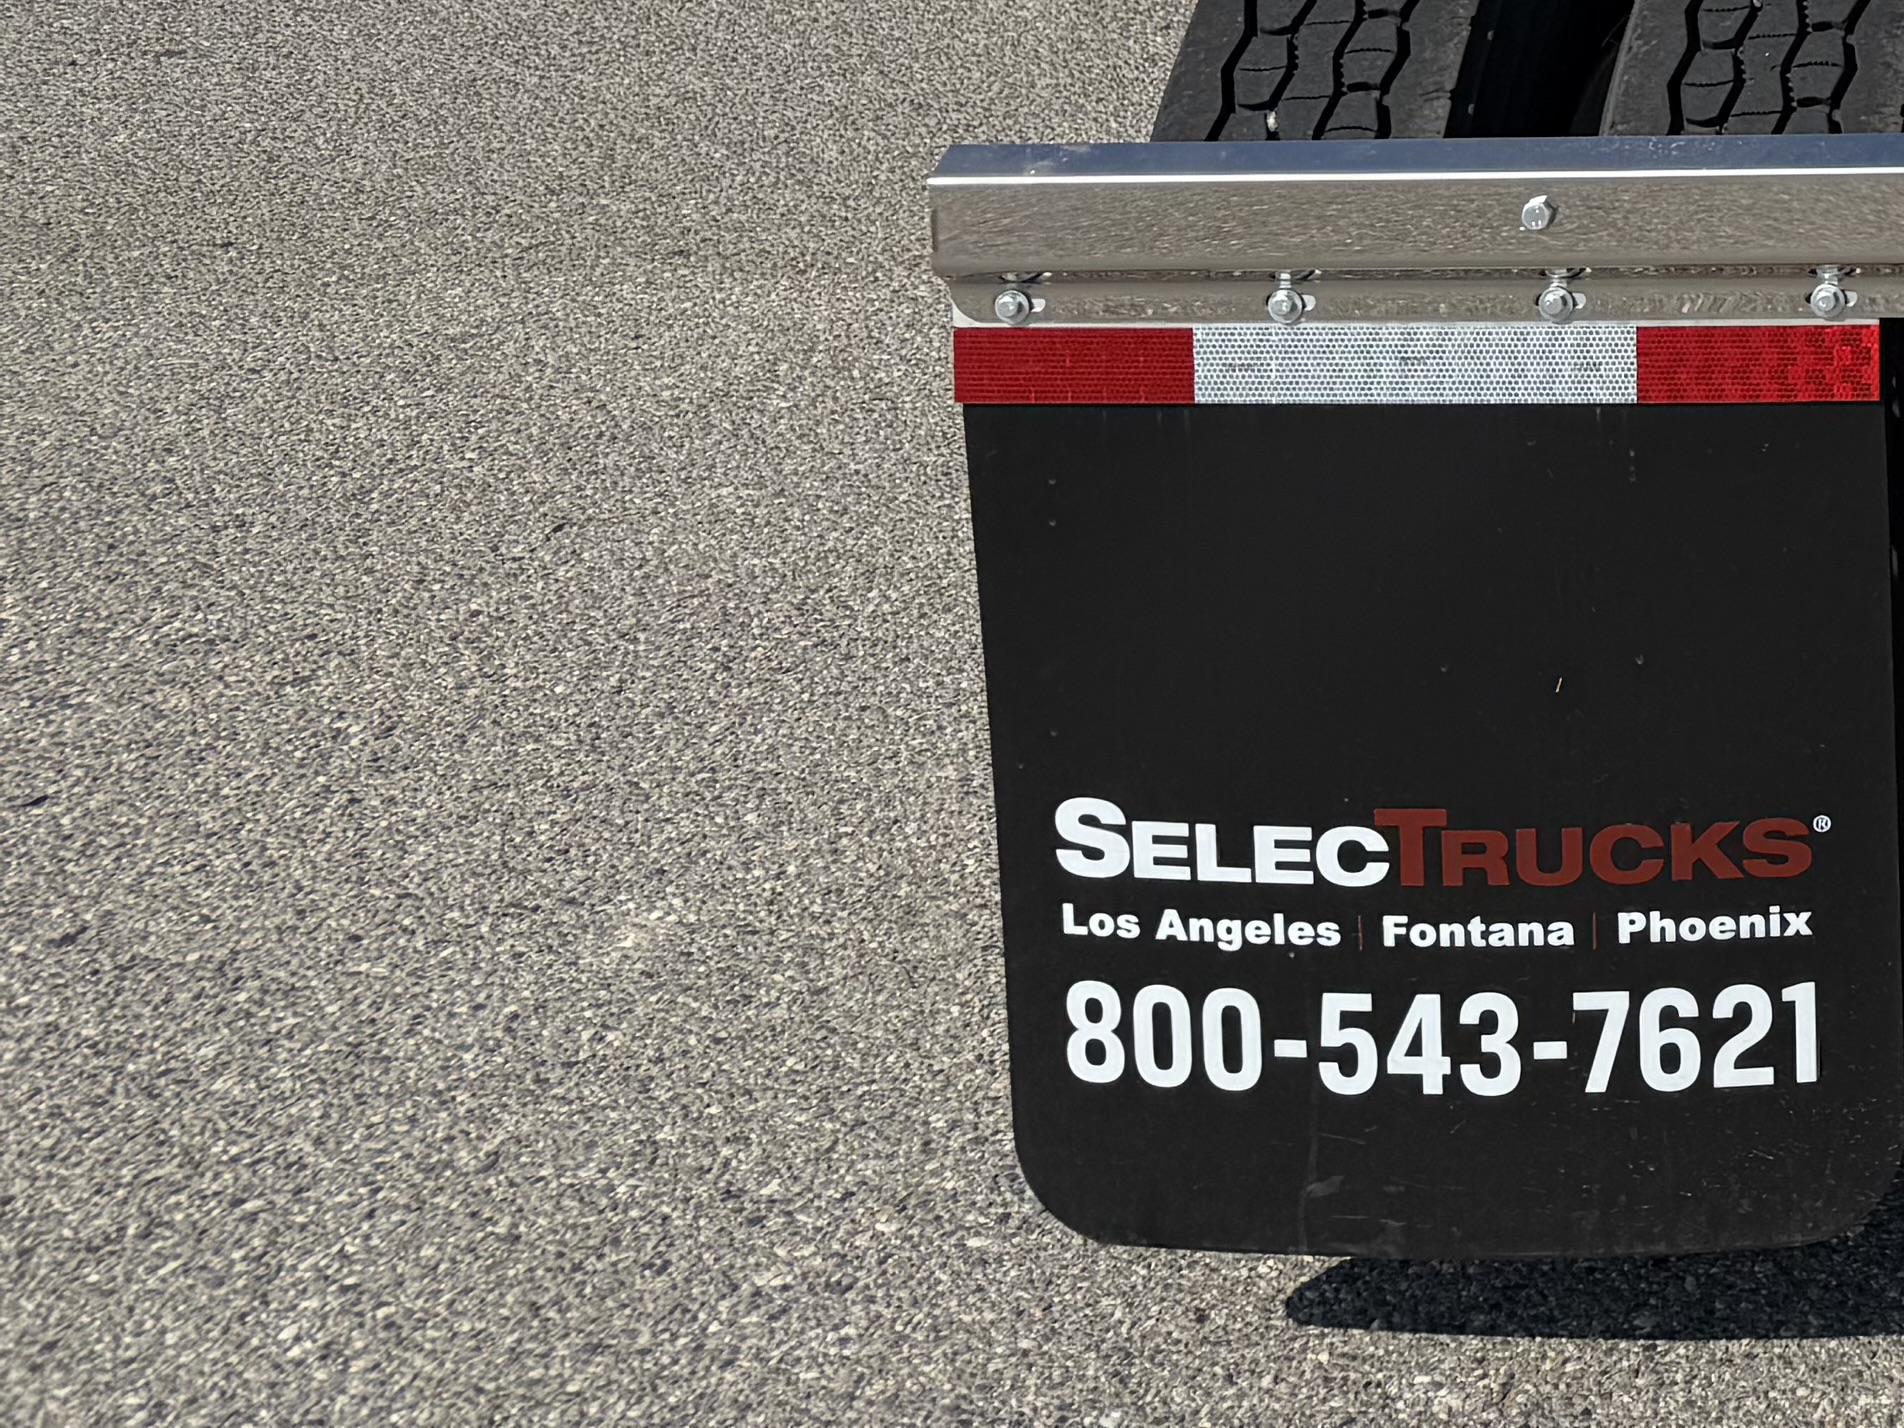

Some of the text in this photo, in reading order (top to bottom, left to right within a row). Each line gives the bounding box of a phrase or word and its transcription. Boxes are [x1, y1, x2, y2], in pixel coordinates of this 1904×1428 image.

[1061, 902, 1813, 952] Los Angeles Fontana Phoenix
[1065, 979, 1818, 1097] 800-543-7621
